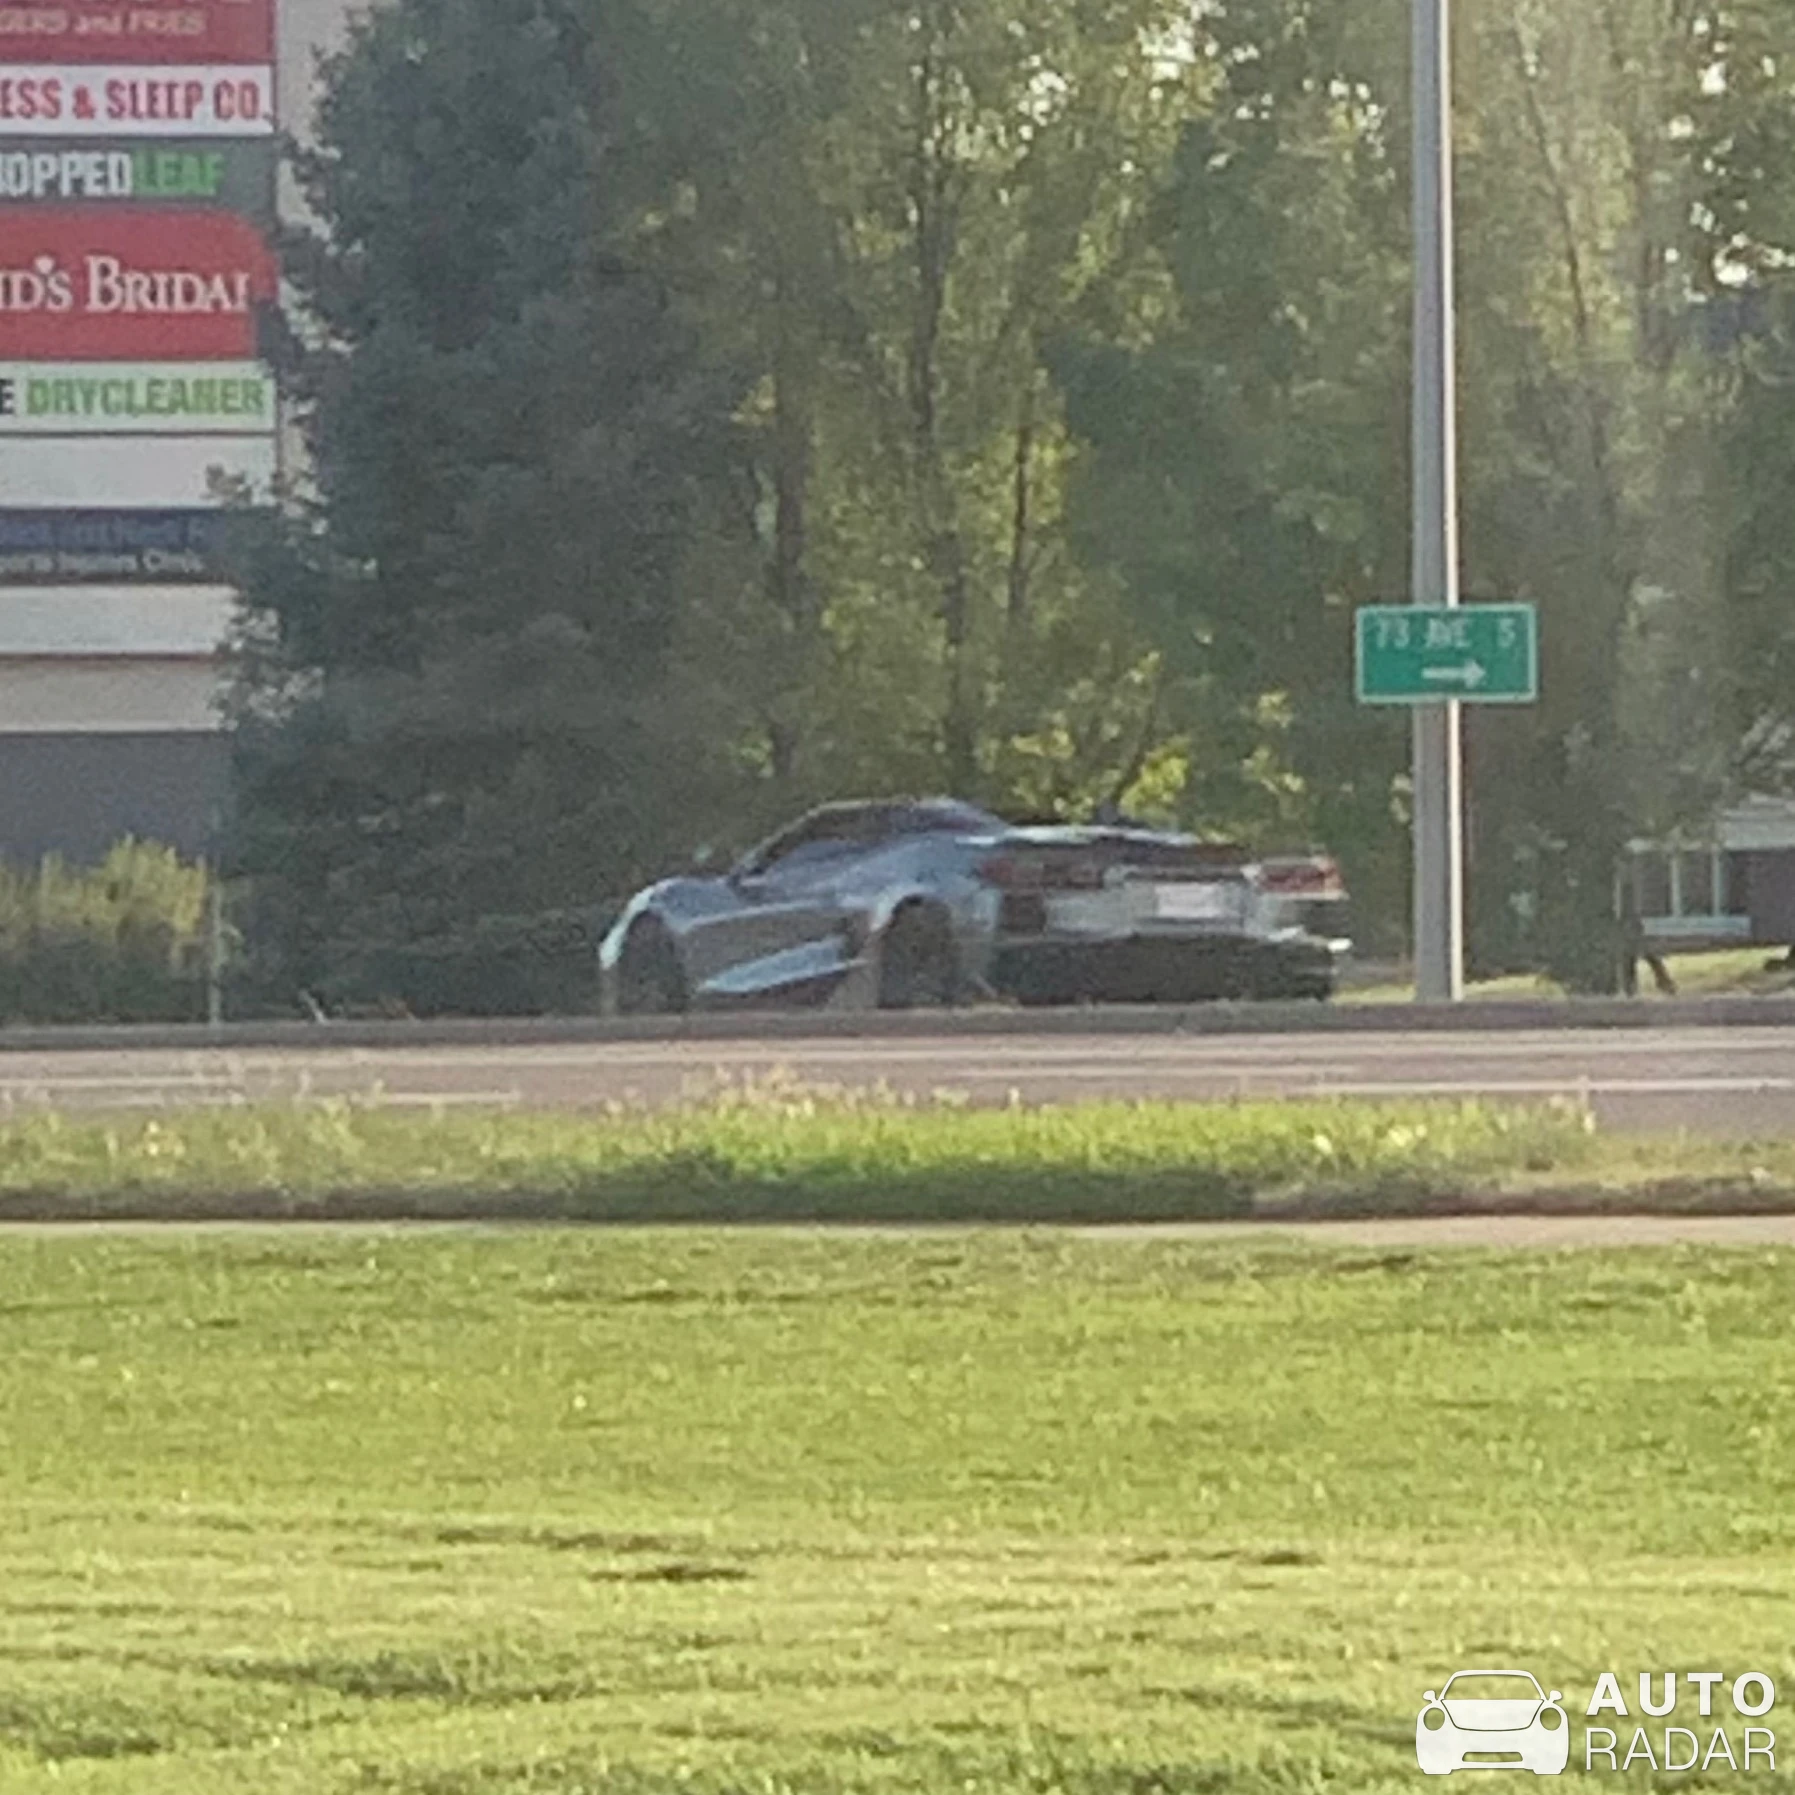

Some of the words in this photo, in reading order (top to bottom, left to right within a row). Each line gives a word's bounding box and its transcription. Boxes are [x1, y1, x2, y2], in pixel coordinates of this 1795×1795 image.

[72, 85, 96, 119] &
[105, 79, 203, 120] SLEEP
[1424, 617, 1474, 648] AVE
